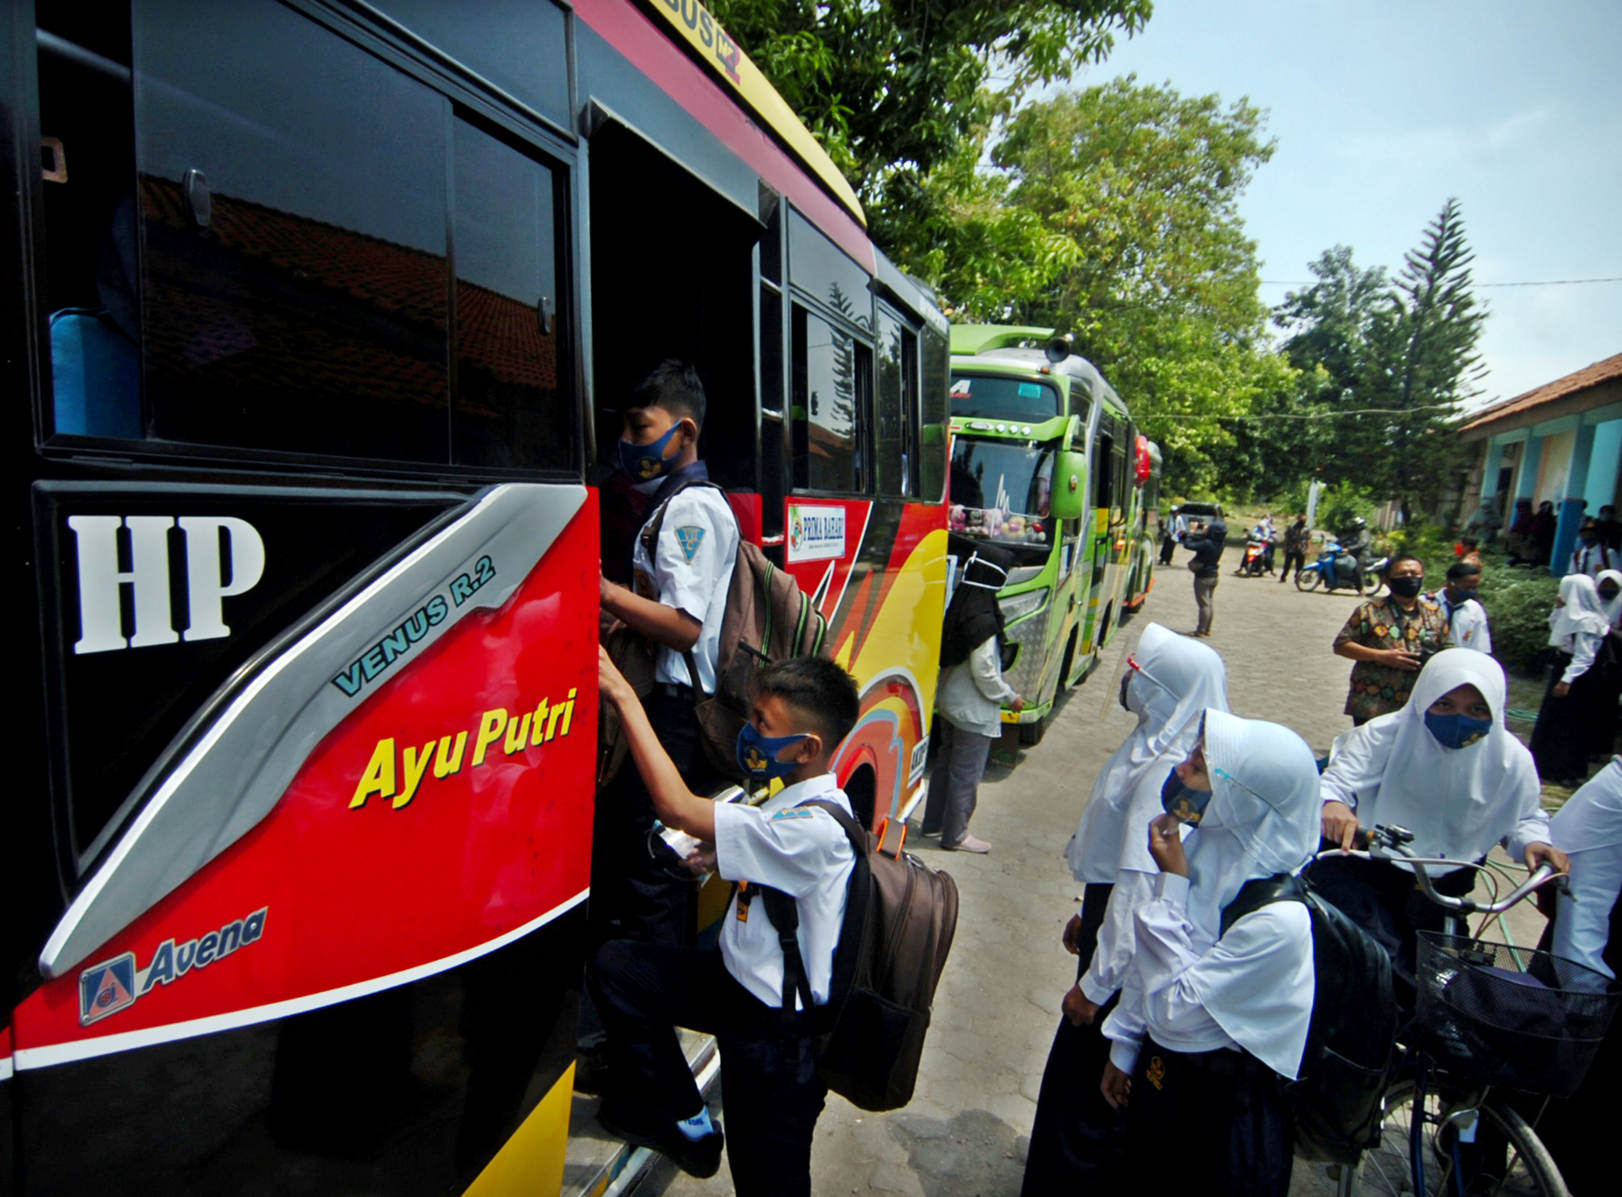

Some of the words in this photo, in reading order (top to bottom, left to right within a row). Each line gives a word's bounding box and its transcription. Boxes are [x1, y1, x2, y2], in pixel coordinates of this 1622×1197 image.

[68, 515, 266, 655] HP
[331, 594, 448, 698] VENUS
[449, 554, 496, 608] R.2
[348, 730, 469, 811] Ayu
[471, 687, 577, 767] Putri
[141, 905, 269, 992] Avena
